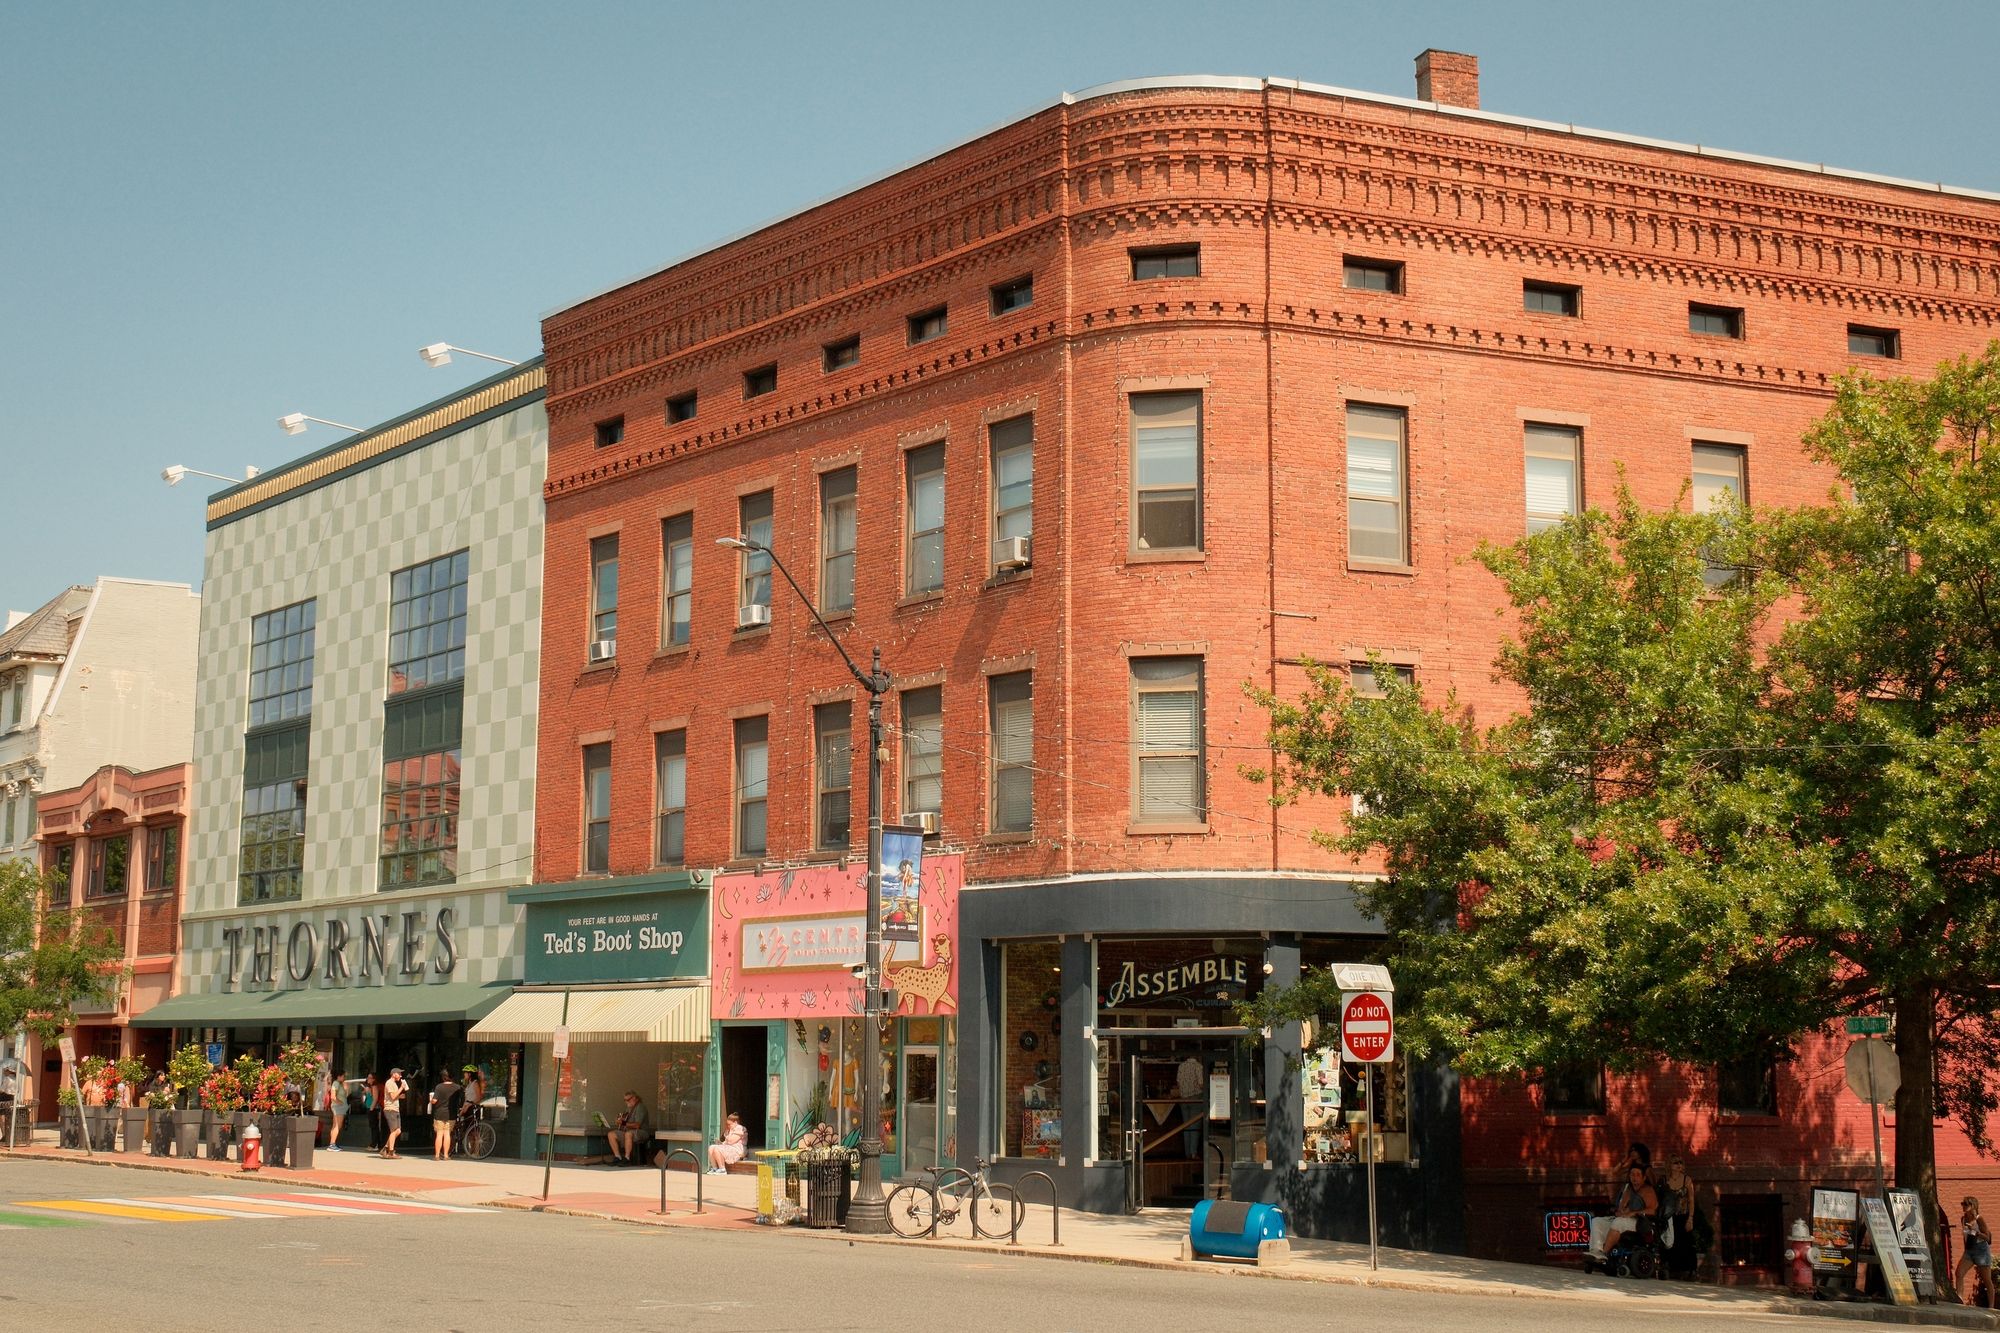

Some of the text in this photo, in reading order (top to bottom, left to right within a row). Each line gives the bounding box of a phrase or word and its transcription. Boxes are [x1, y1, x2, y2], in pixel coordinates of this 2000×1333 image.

[568, 913, 658, 926] YOUR FEET ARE IN GOOD HANDS AT
[222, 906, 458, 985] THORNES
[543, 926, 683, 955] Ted's Boot Shop
[1106, 958, 1248, 1008] ASSEMBLE
[1350, 1006, 1385, 1018] DO NOT
[1353, 1037, 1385, 1048] ENTER
[1552, 1216, 1585, 1229] USED
[1550, 1230, 1589, 1243] BOOKS
